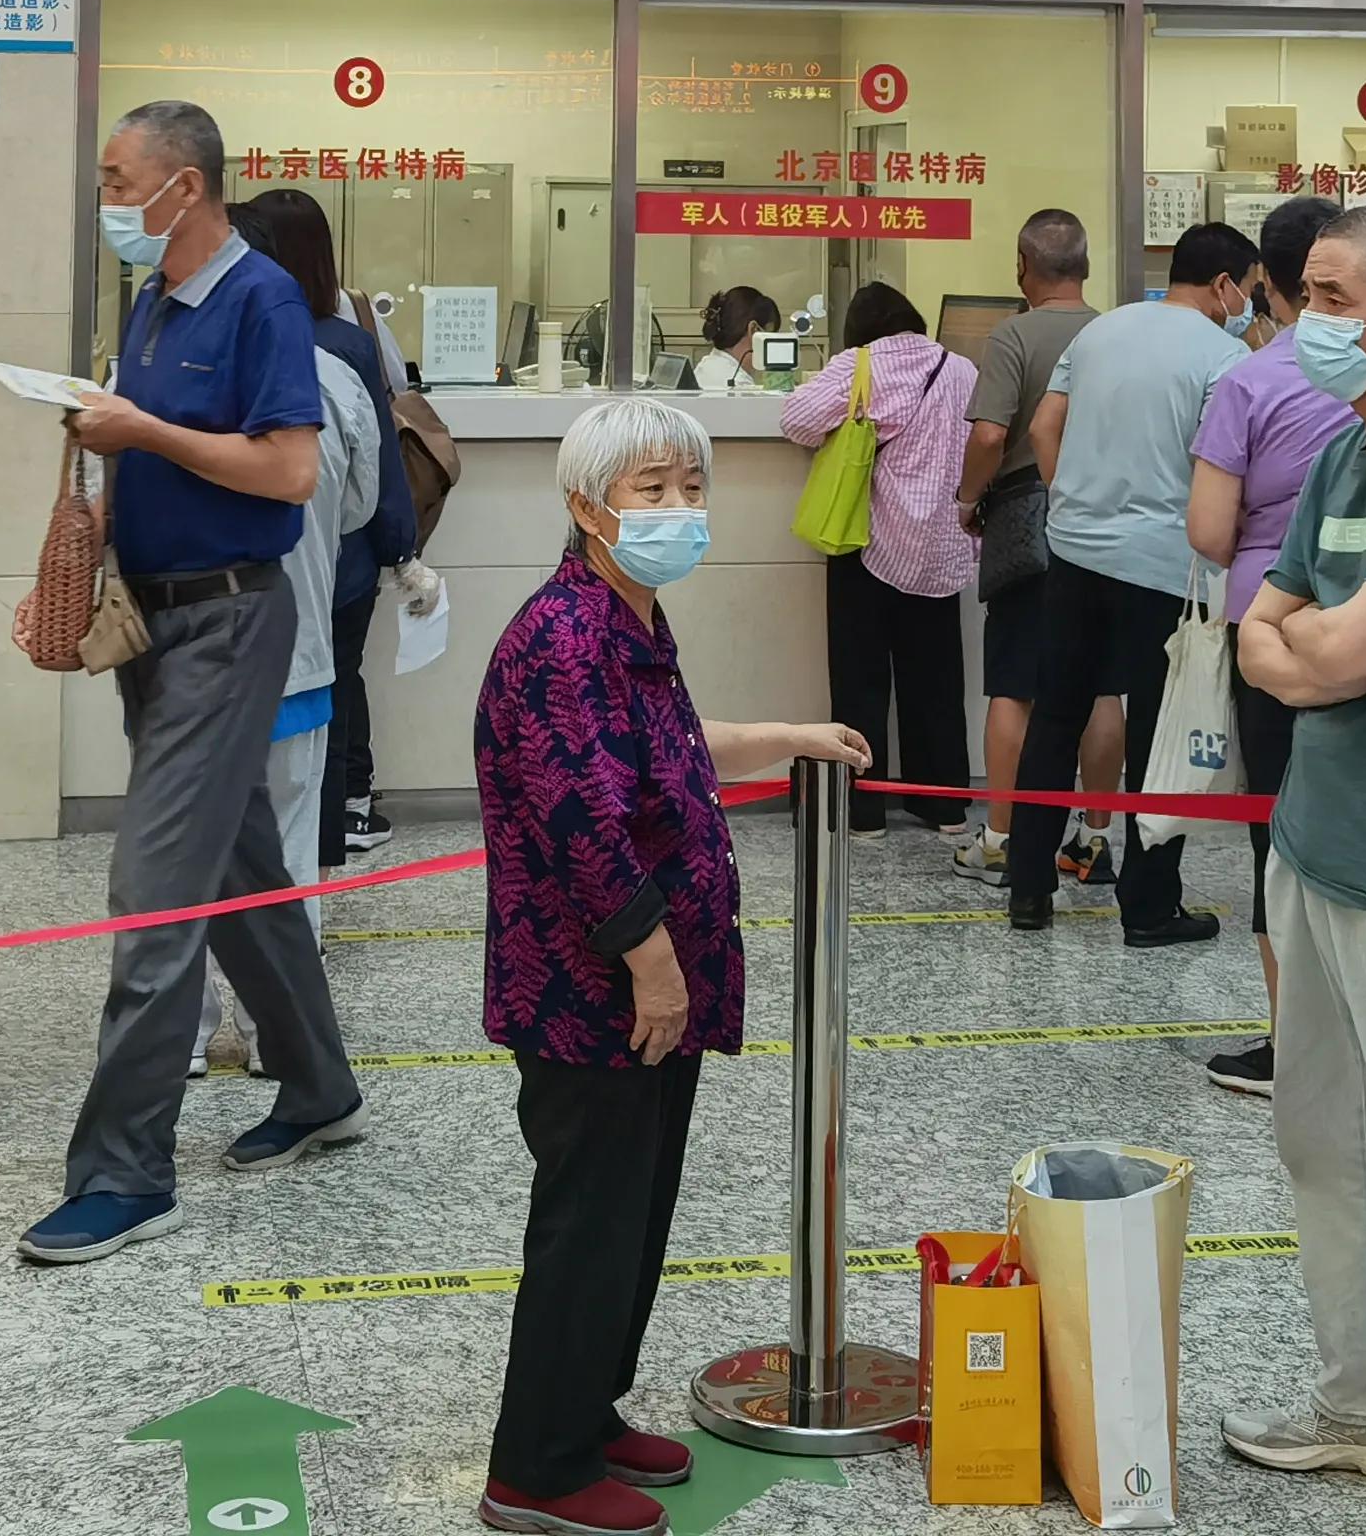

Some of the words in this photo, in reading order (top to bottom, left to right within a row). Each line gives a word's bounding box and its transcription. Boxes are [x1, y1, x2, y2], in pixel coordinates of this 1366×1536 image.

[348, 66, 372, 99] 8
[873, 73, 896, 105] 9
[239, 147, 466, 181] 北京医保特病
[775, 150, 986, 185] 北京医保特病
[681, 201, 927, 230] 军人（退役军人）优先
[1185, 1235, 1299, 1255] 您间隔
